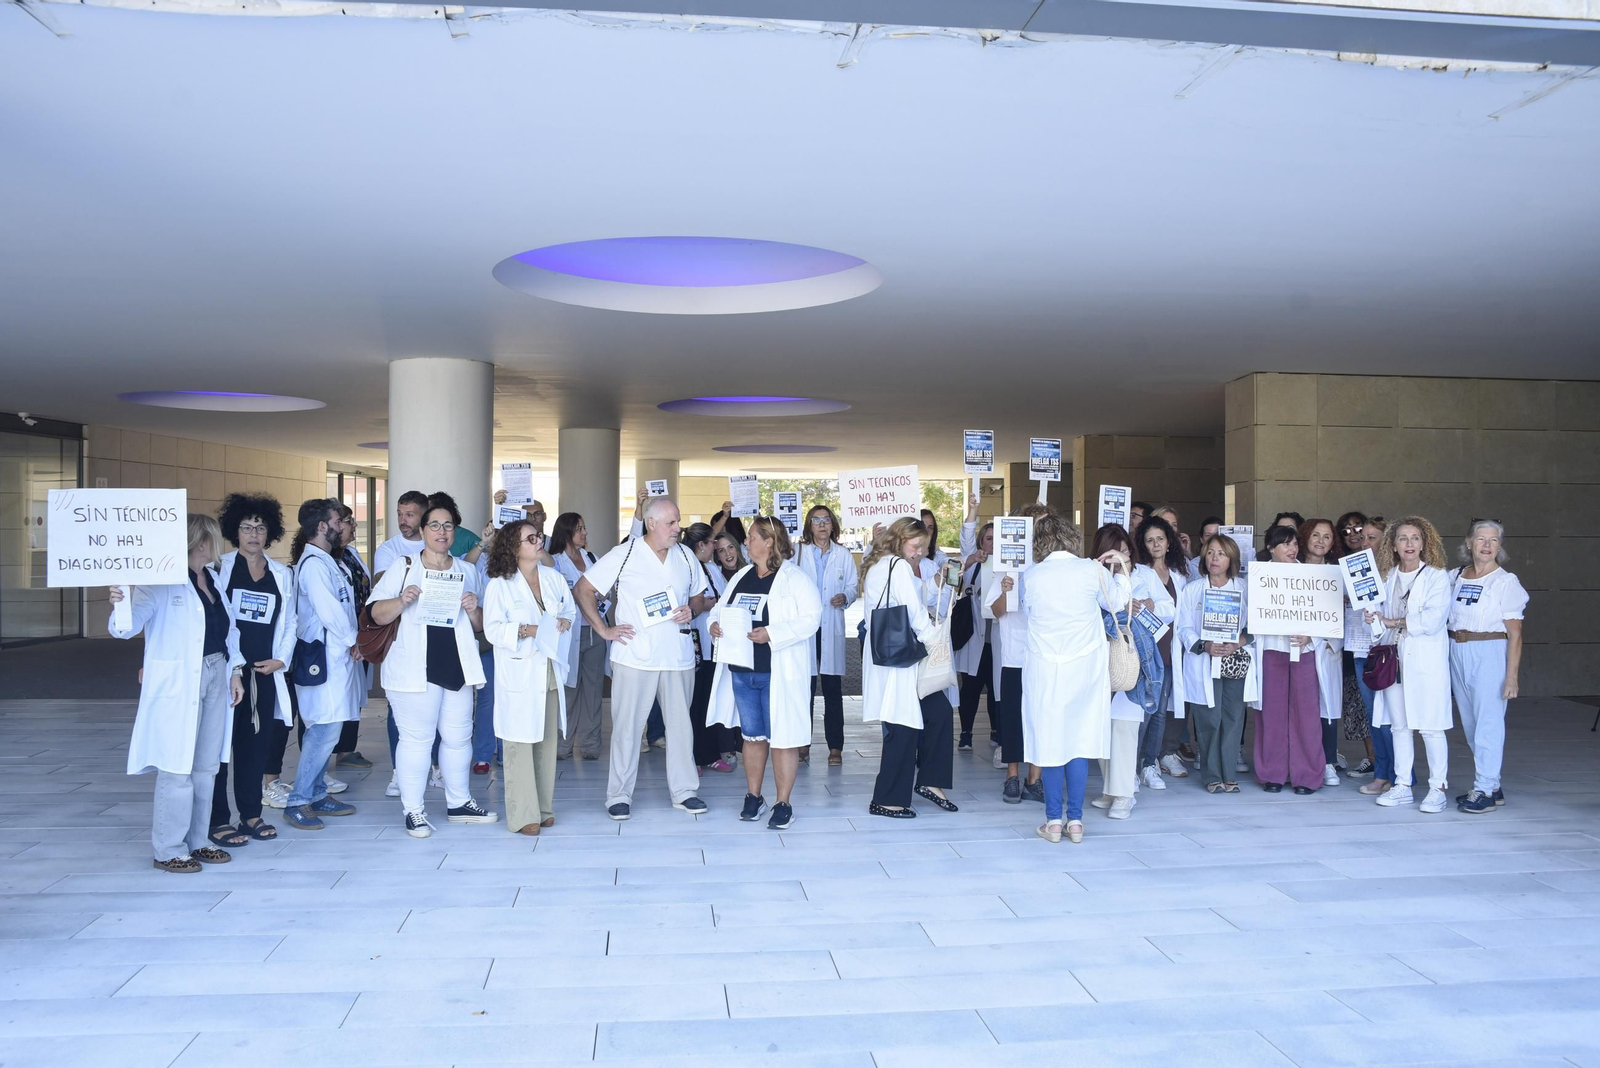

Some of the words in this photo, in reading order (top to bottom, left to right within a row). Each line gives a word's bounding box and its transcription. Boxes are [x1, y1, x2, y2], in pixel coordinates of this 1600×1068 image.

[984, 450, 992, 458] TSS
[1031, 457, 1049, 465] HUELGA
[1050, 458, 1059, 466] TSS
[848, 477, 865, 490] SIN
[858, 493, 871, 502] NO
[876, 491, 895, 502] HAY
[73, 505, 108, 522] SIN
[112, 506, 178, 522] TÉCNICOS
[848, 503, 916, 516] TRATAMIENTOS
[88, 535, 107, 546] NO
[117, 534, 143, 546] HAY
[58, 556, 154, 570] DIAGNÓSTICO
[1259, 575, 1279, 588] SIN
[1270, 594, 1285, 605] NO
[1292, 595, 1314, 607] HAY
[1204, 611, 1226, 623] HUELGA
[1227, 613, 1239, 624] TSS
[1256, 608, 1338, 623] TRATAMIENTOS
